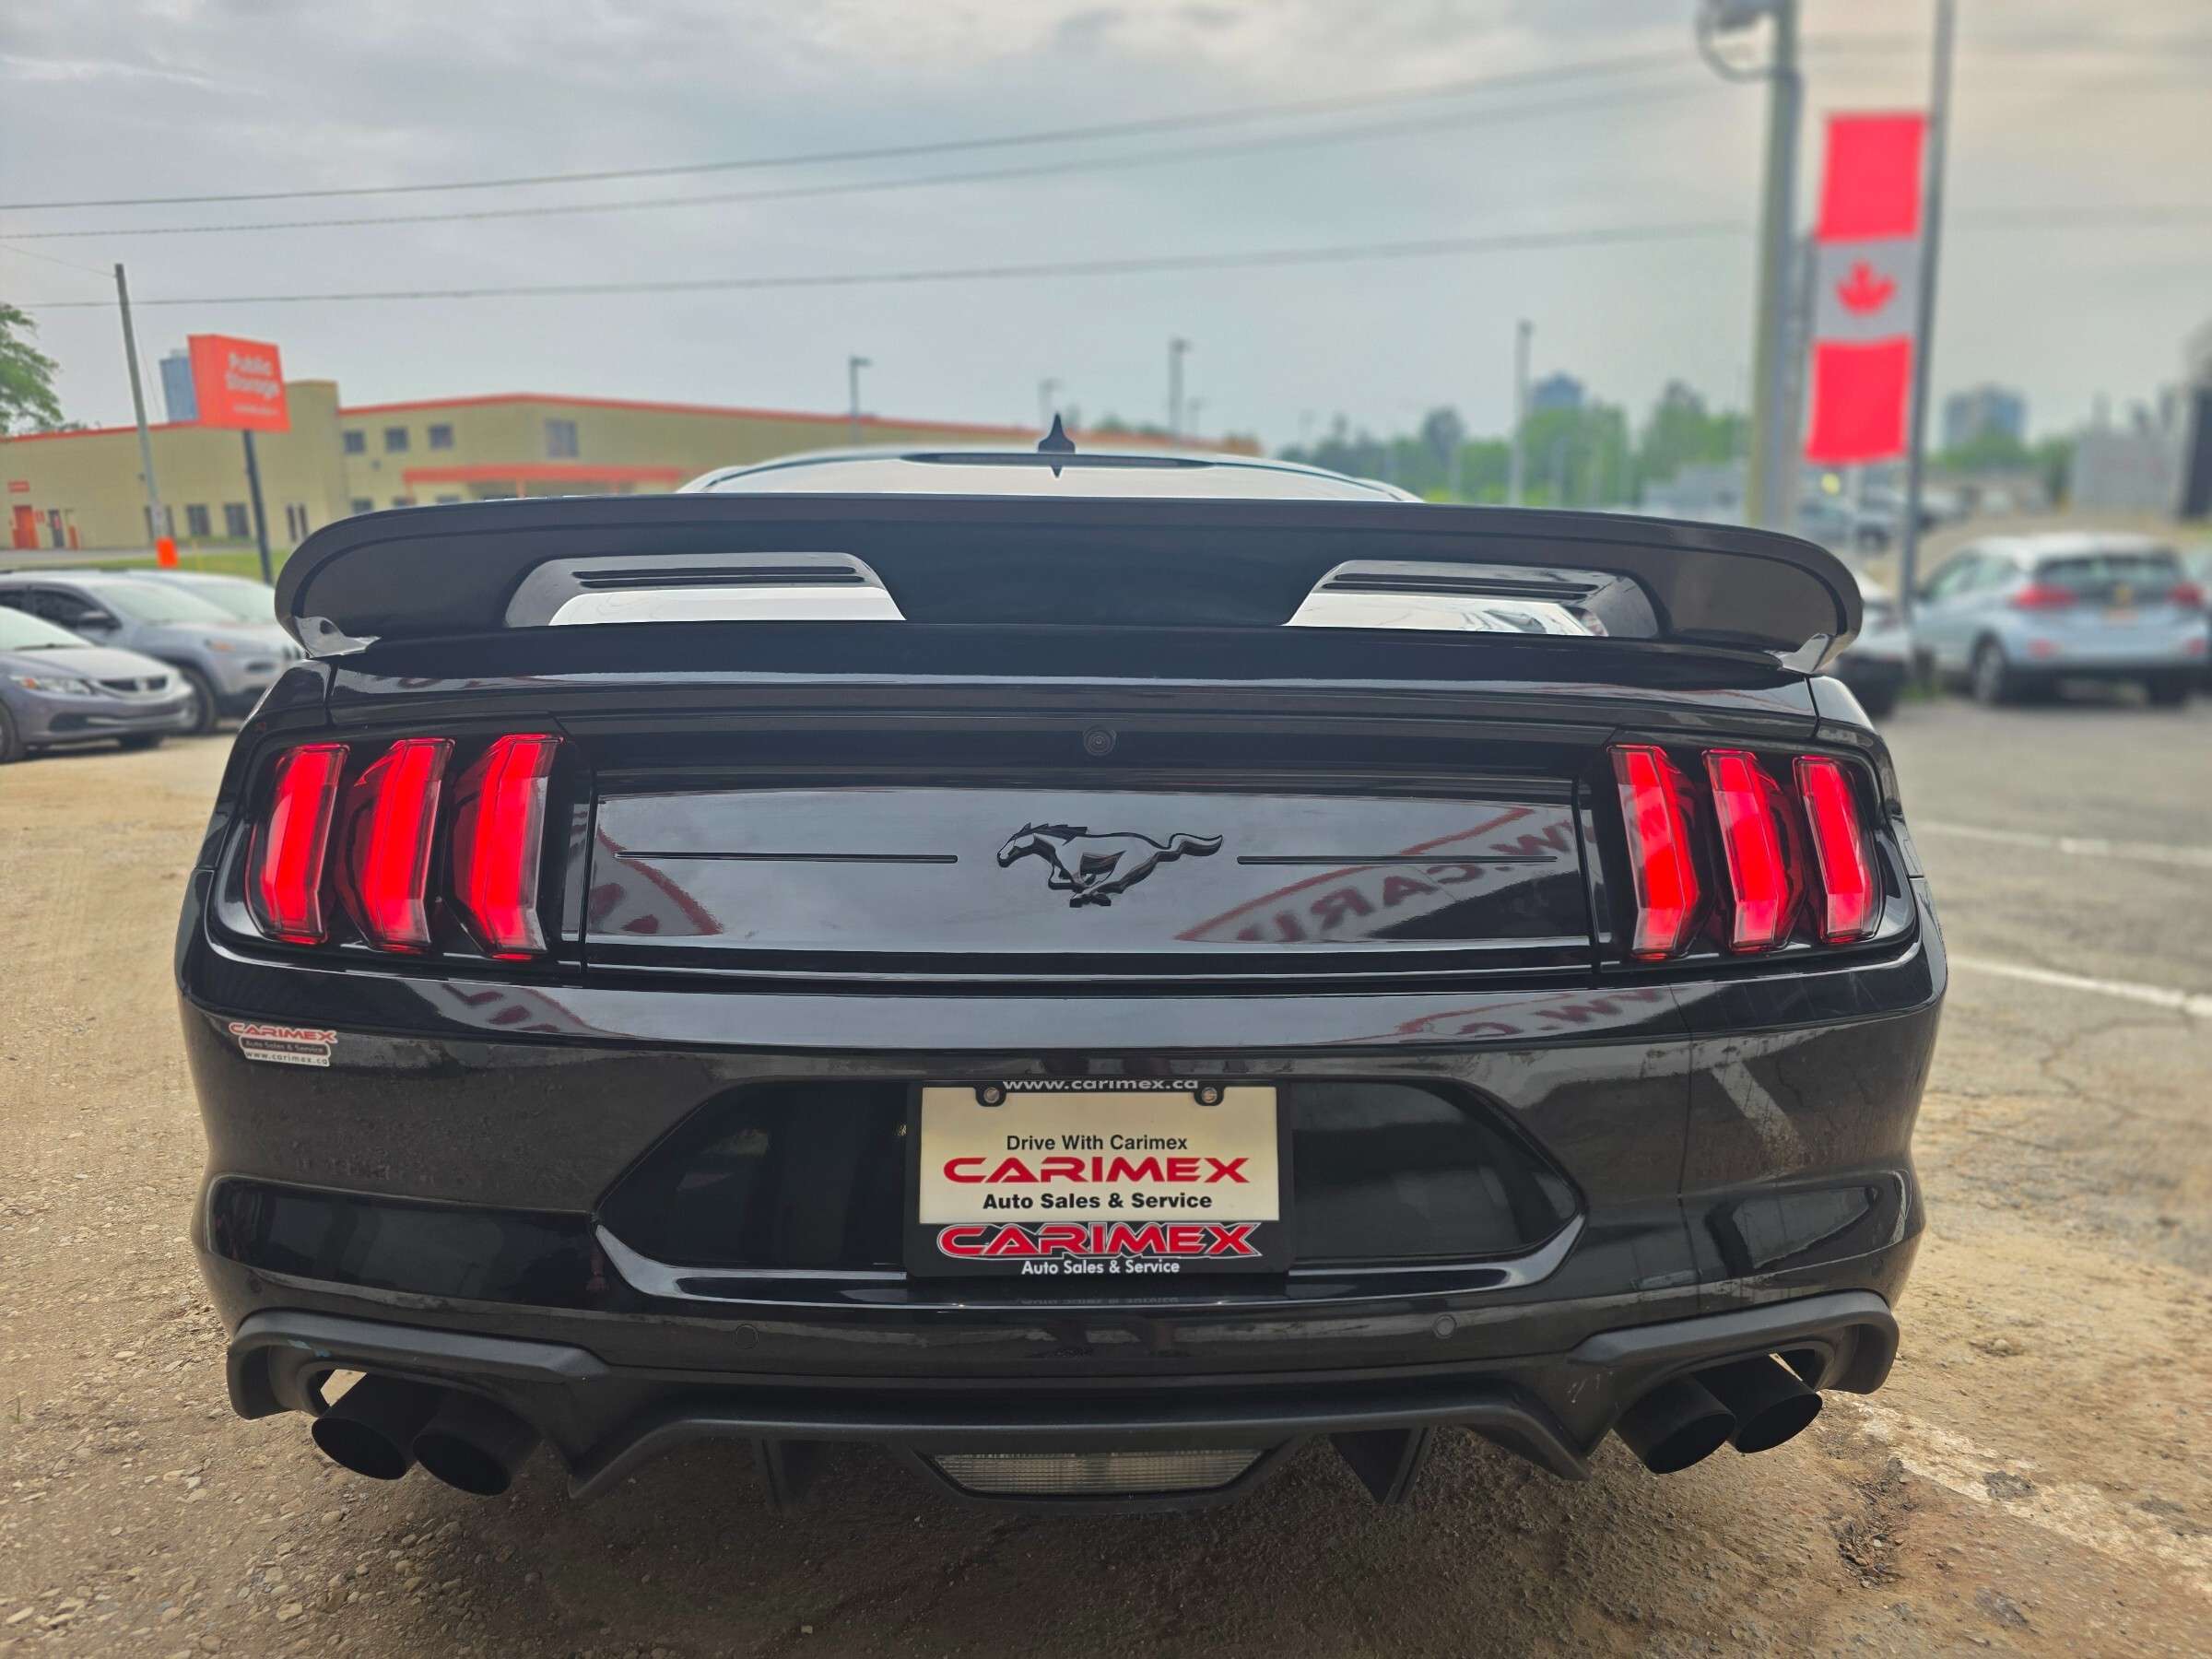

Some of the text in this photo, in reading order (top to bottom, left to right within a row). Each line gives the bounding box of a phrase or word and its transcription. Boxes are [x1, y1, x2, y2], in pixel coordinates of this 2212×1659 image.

[229, 1022, 337, 1043] CARIMEX
[1003, 1078, 1198, 1090] www.carimex.ca
[1006, 1134, 1188, 1150] Drive With Carimex
[943, 1156, 1250, 1183] CARIMEX
[982, 1192, 1213, 1209] Auto Sales & Service
[938, 1222, 1261, 1259] CARIMEX
[1021, 1258, 1181, 1275] Auto Sales & Service
